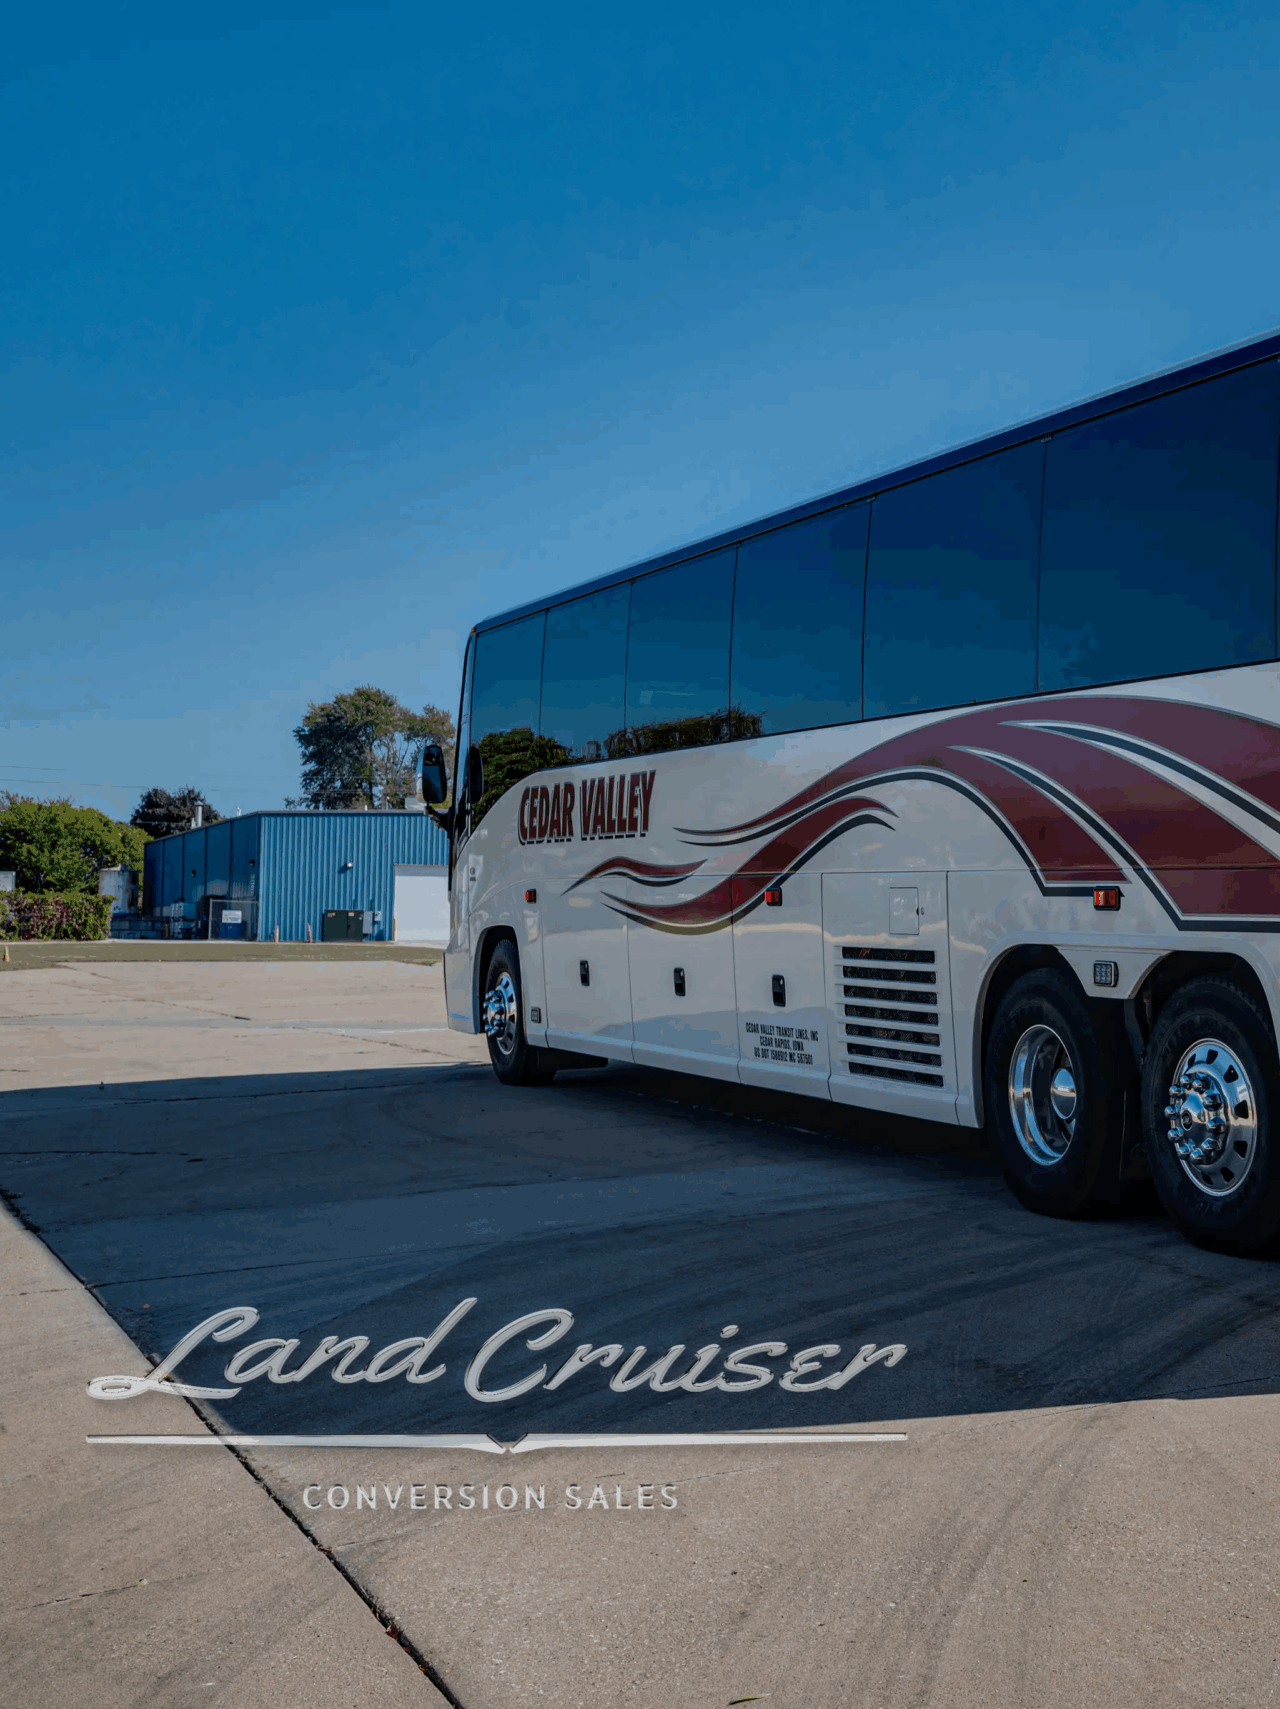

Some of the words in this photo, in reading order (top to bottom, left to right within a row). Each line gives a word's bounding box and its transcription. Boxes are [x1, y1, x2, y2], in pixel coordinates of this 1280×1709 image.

[518, 781, 575, 845] CEDAR
[580, 769, 657, 841] VALLEY
[746, 1022, 760, 1034] CEDAR
[760, 1024, 775, 1036] VALLEY
[776, 1025, 794, 1038] TRANSIT
[795, 1028, 810, 1042] LINES,
[810, 1030, 819, 1042] INC
[760, 1035, 773, 1047] CEDAR
[774, 1037, 792, 1051] RAPIDS,
[792, 1040, 804, 1052] IOWA
[754, 1047, 760, 1058] US
[761, 1048, 769, 1059] DOT
[788, 1052, 796, 1063] MC
